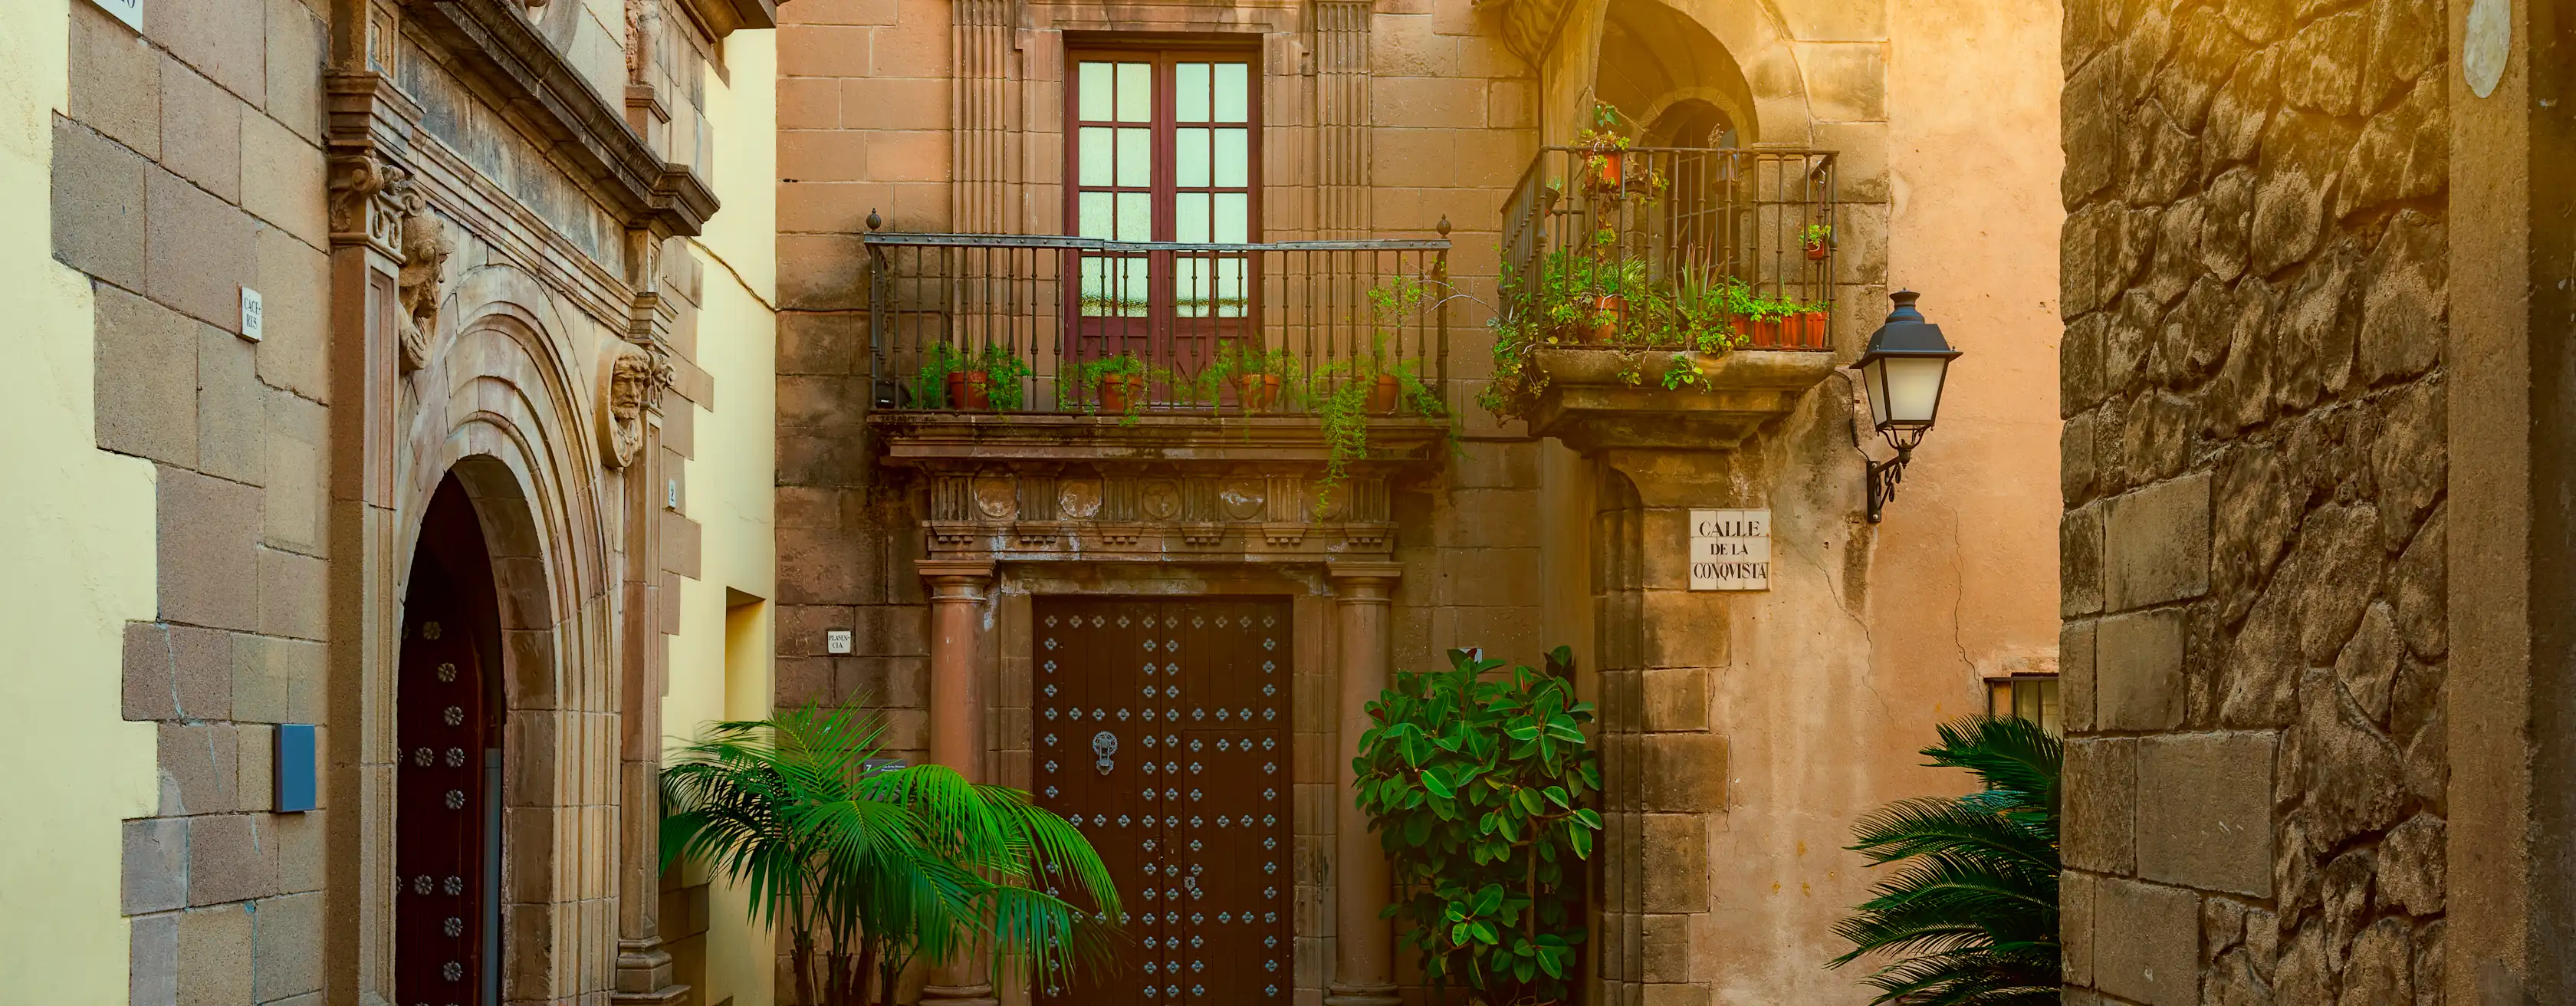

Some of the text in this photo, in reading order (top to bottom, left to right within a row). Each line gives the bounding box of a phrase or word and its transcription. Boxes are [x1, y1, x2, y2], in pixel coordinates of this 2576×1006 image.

[246, 314, 258, 330] RES
[1699, 521, 1761, 537] CALLE
[1710, 544, 1749, 555] DE LA
[1694, 563, 1766, 581] CONQVISTA
